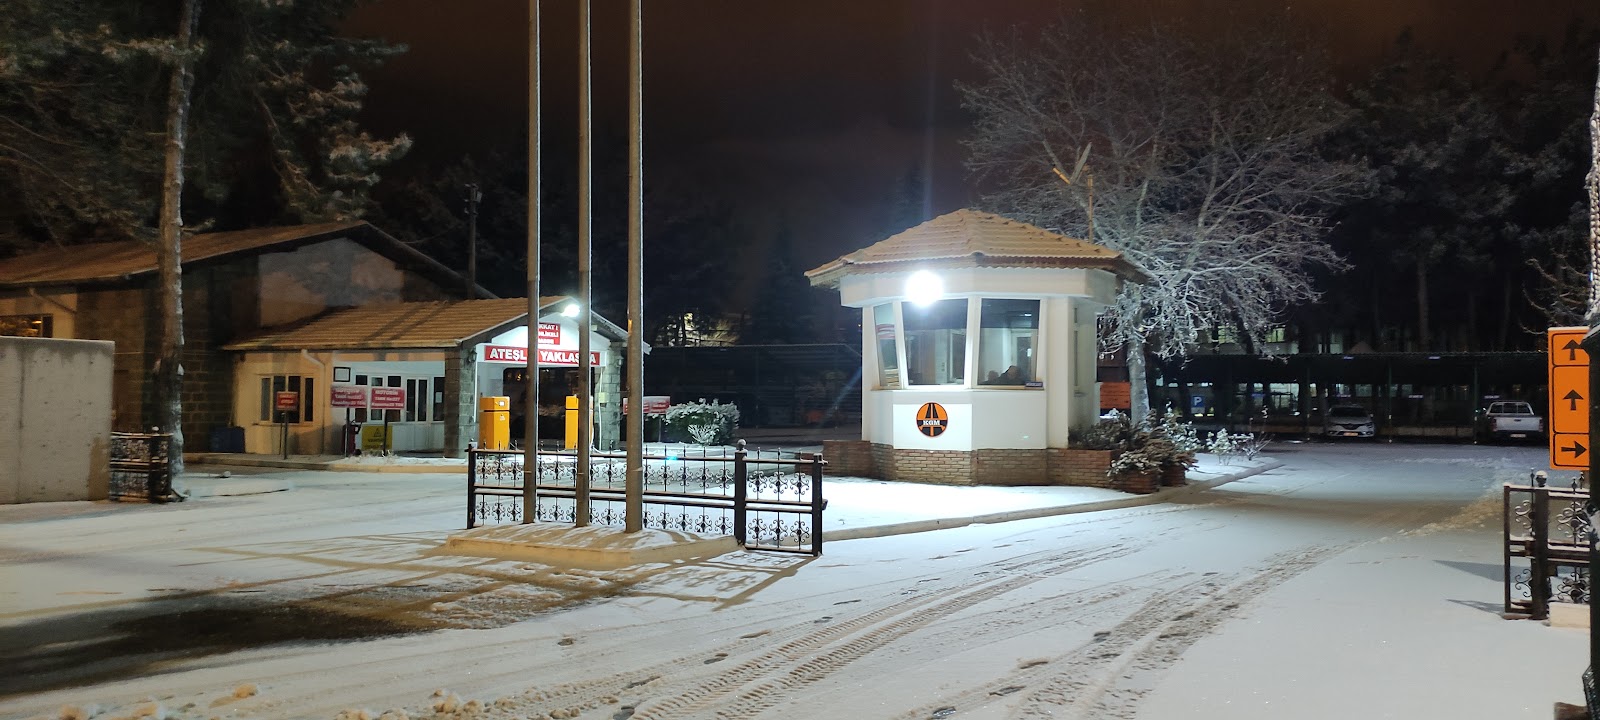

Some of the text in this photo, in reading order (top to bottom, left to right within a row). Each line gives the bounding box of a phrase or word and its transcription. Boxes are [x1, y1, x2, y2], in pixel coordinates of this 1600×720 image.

[489, 348, 597, 364] ATEŞL YAKLAŞA
[1194, 396, 1203, 406] P
